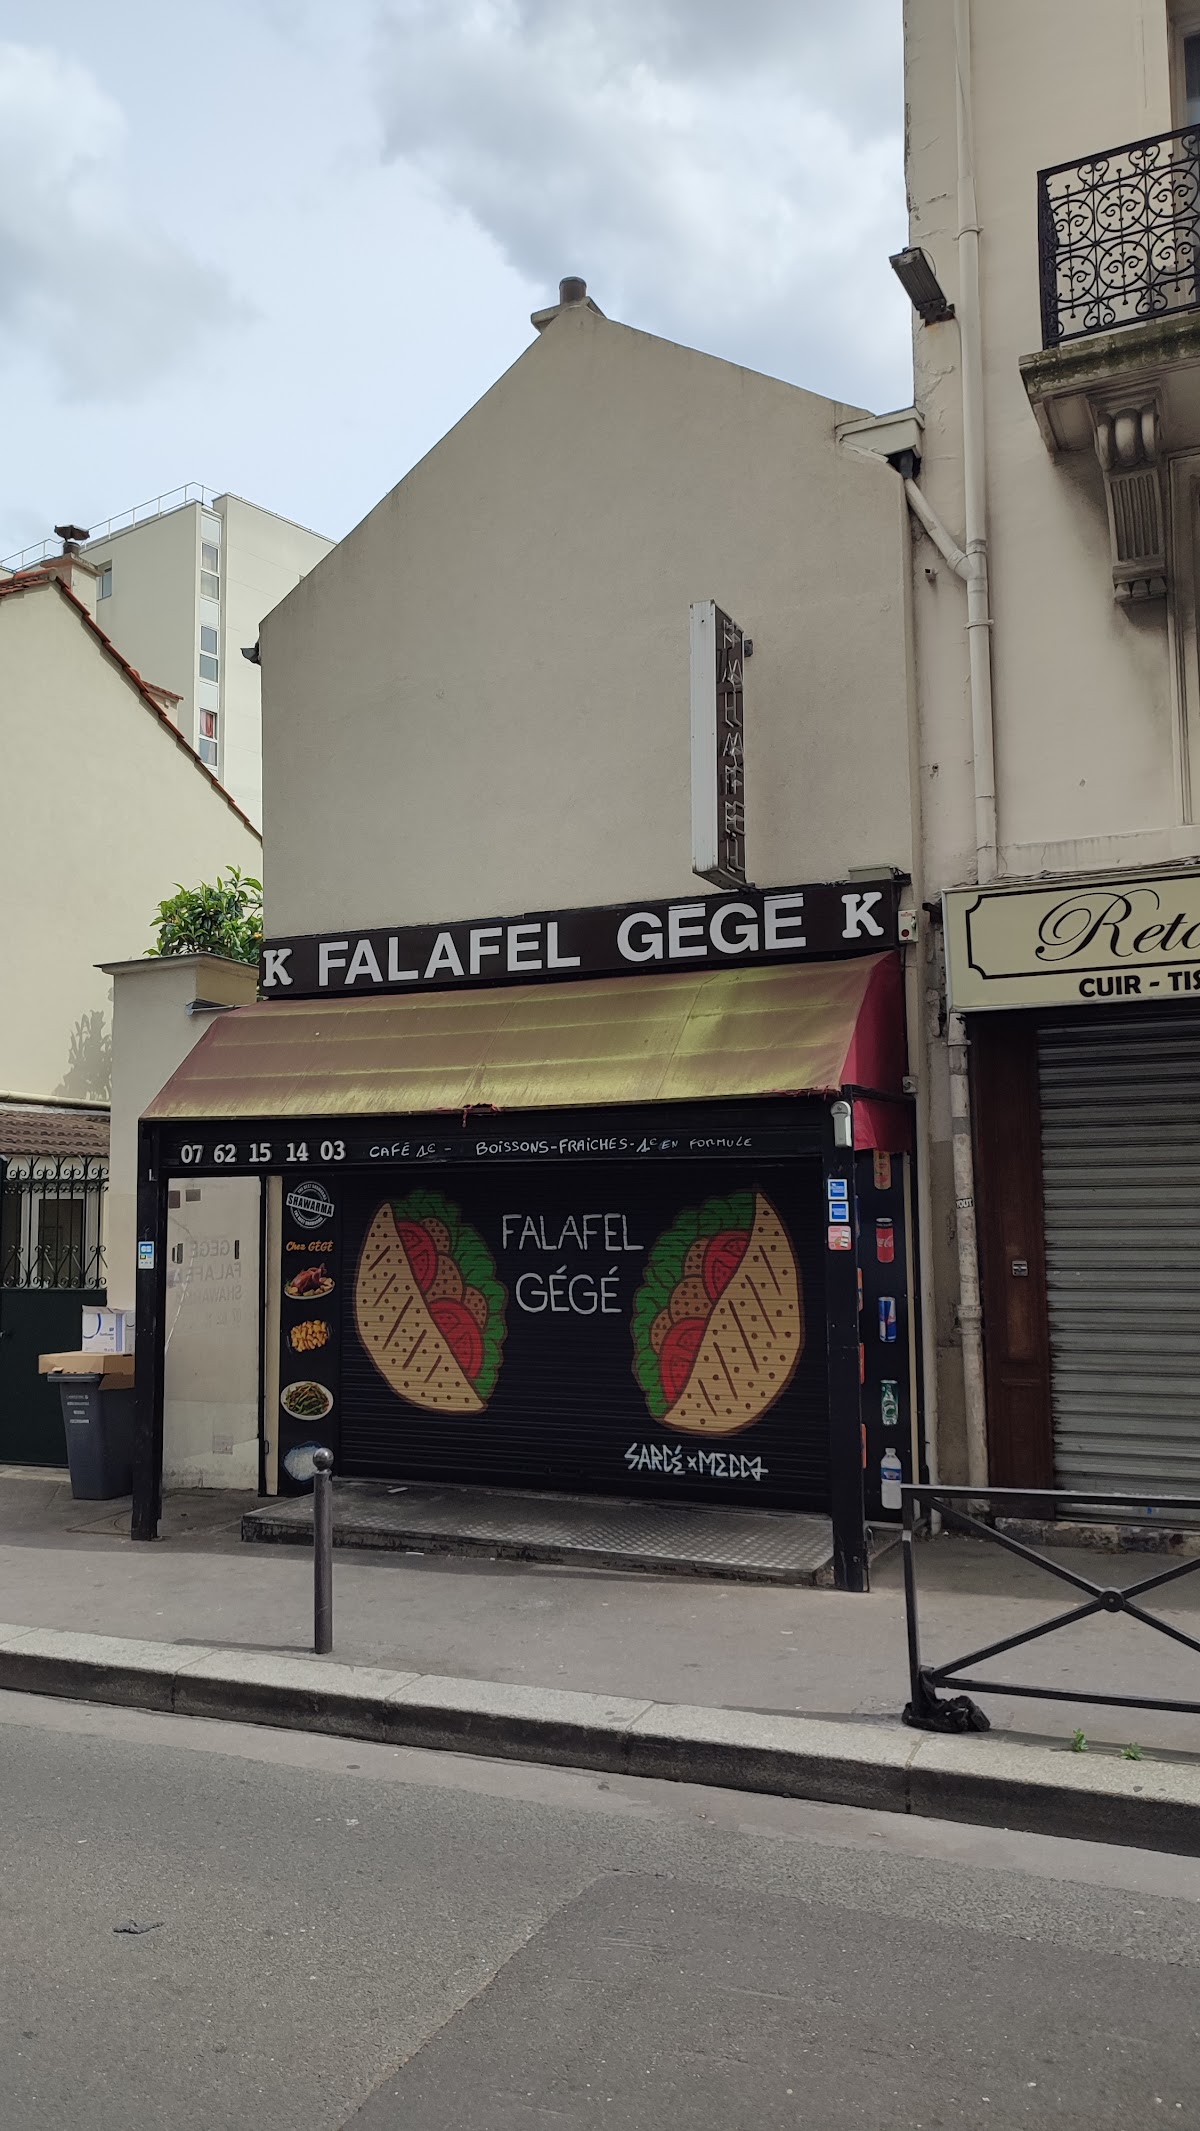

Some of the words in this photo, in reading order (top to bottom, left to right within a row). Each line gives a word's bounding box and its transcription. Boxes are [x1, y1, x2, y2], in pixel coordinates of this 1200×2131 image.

[262, 948, 294, 987] K
[318, 921, 581, 987] FALAFEL
[841, 891, 885, 939] K
[1079, 975, 1142, 998] CUIR
[181, 1144, 204, 1163] 07
[213, 1143, 237, 1163] 62
[249, 1142, 272, 1163] 15
[286, 1142, 309, 1162] 14
[320, 1140, 346, 1161] 03
[287, 1194, 333, 1216] SHAWARMA
[502, 1213, 645, 1251] FALAFEL
[286, 1240, 306, 1252] Chez
[515, 1264, 623, 1315] GÉGÉ
